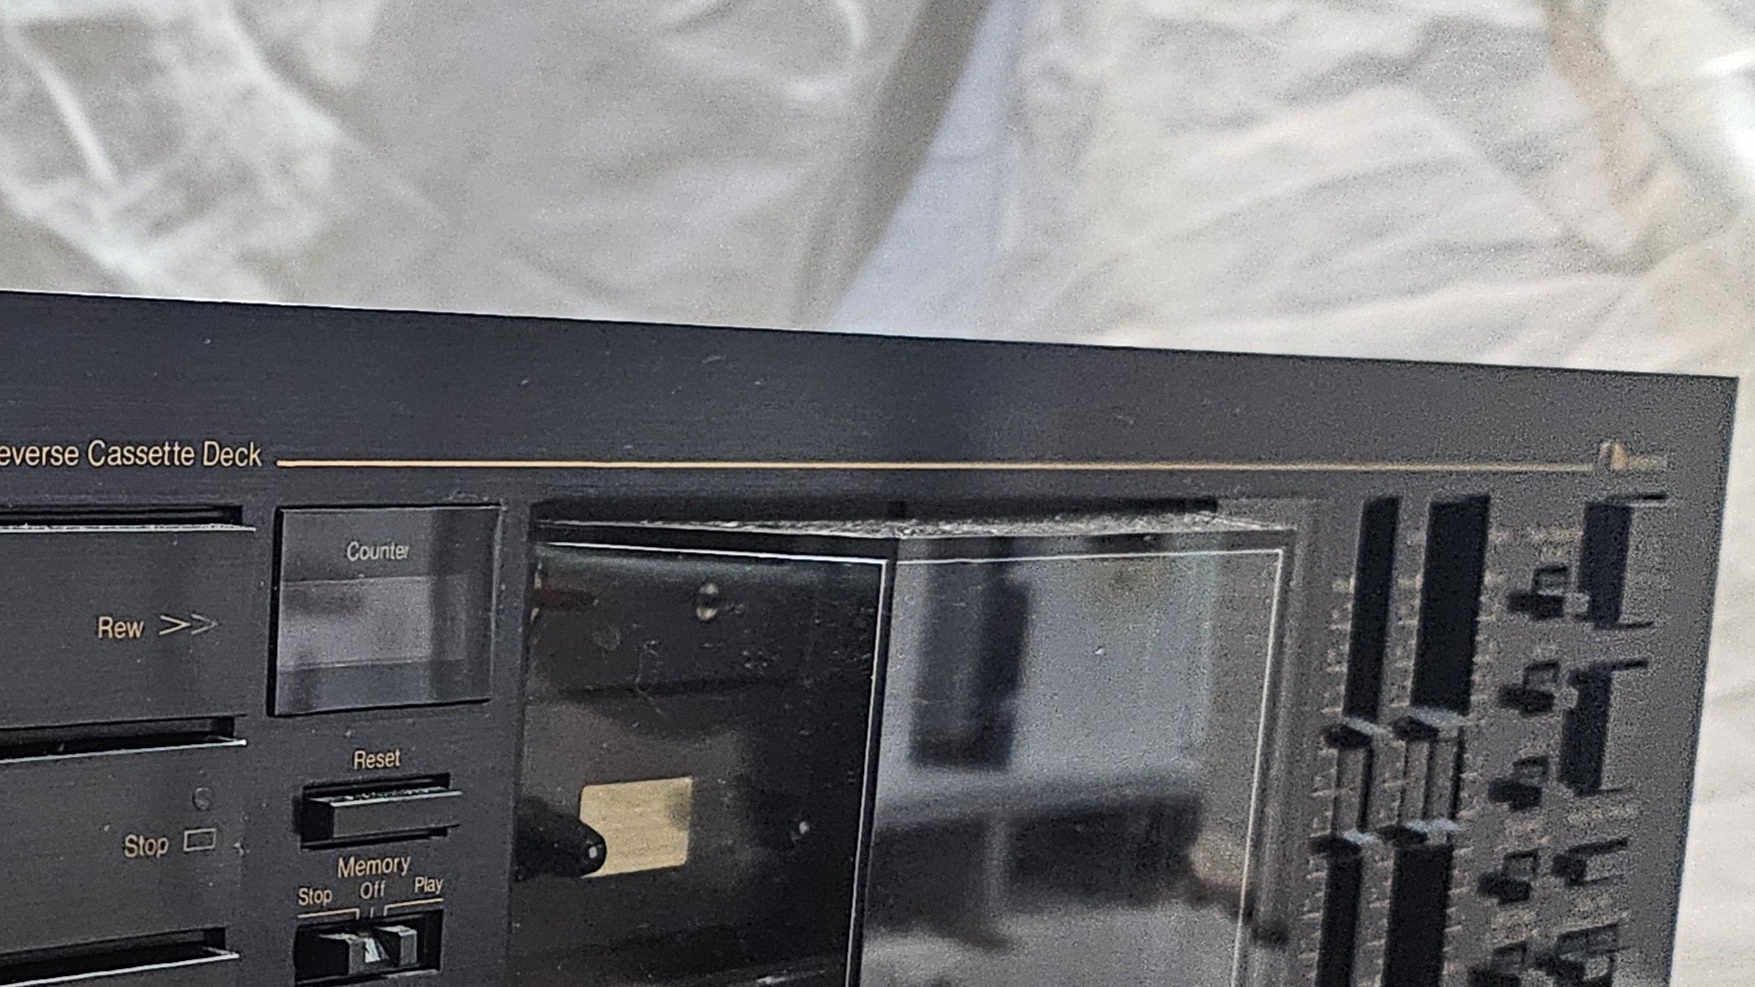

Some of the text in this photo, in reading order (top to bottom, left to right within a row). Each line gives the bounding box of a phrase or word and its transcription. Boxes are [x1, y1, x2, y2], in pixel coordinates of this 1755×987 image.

[86, 438, 198, 470] Cassette
[202, 440, 263, 469] Deck
[346, 541, 410, 563] Counter
[96, 614, 145, 641] Rew
[352, 749, 402, 771] Reset
[124, 833, 170, 861] Stop
[337, 855, 412, 881] Memory
[297, 875, 445, 909] Stop Off Play
